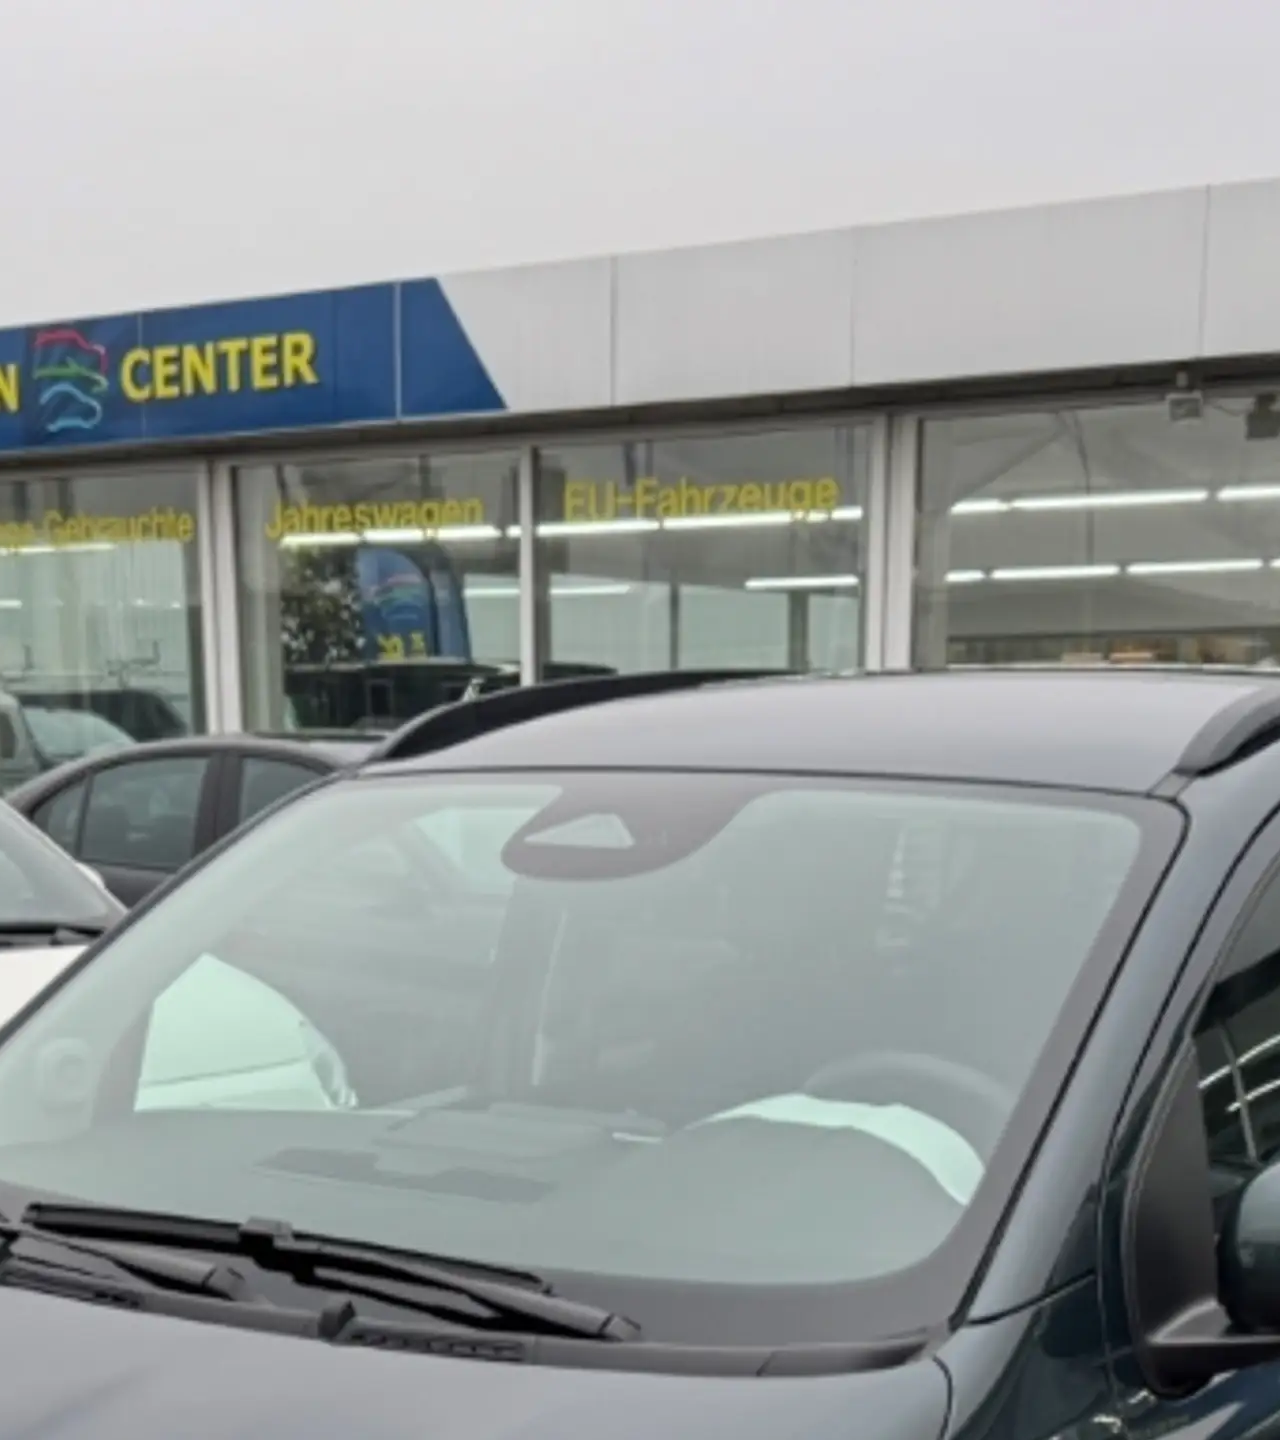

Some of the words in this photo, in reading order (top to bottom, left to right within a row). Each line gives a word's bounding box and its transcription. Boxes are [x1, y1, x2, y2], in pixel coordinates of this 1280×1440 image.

[120, 331, 319, 402] CENTER
[264, 495, 484, 543] Jahreswagen
[564, 474, 840, 525] EU-Fahrzeuge
